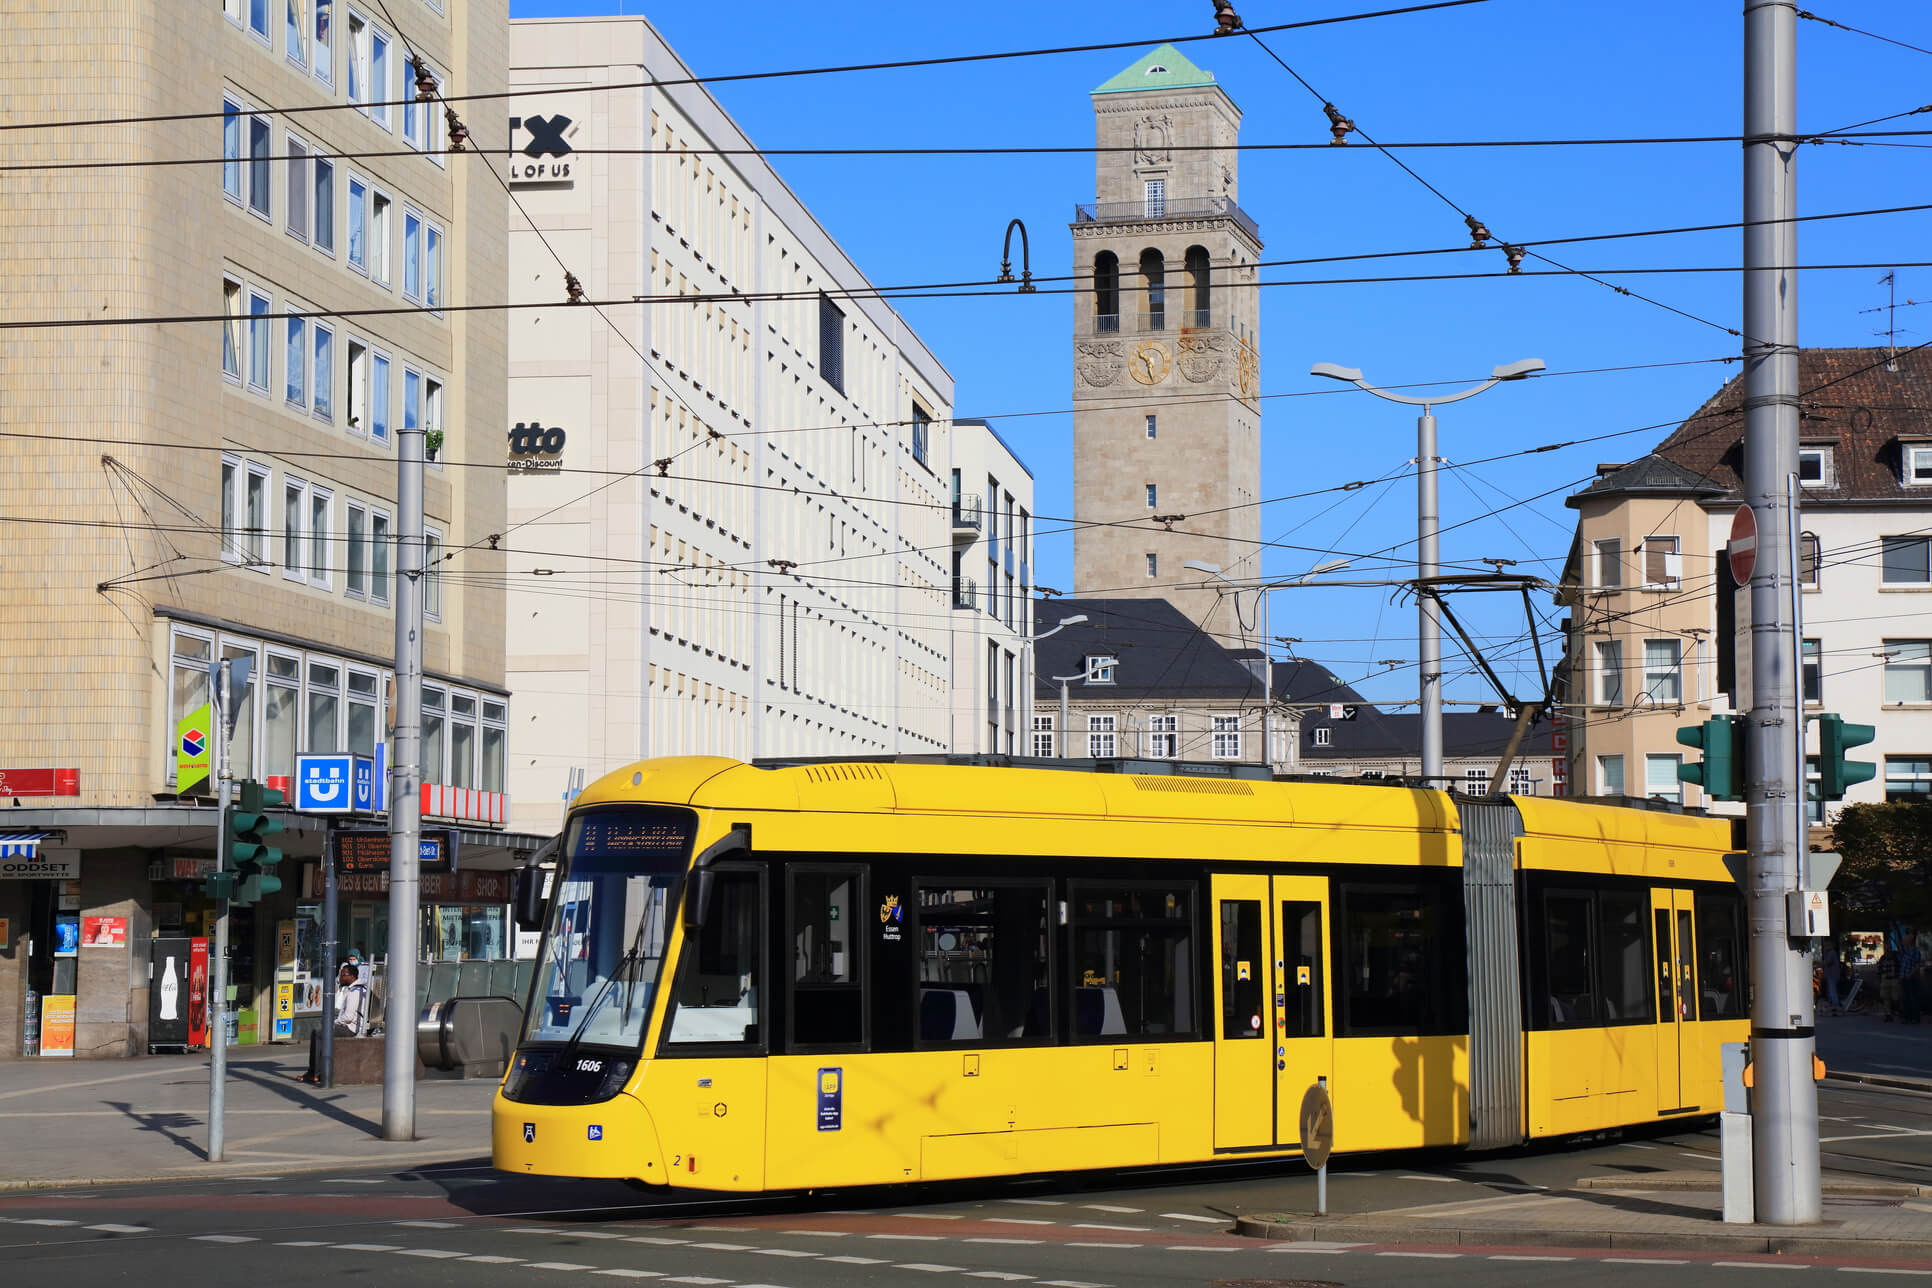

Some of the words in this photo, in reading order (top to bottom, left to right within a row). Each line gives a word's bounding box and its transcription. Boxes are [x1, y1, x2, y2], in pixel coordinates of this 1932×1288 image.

[524, 164, 545, 178] OF
[552, 163, 570, 178] US
[508, 422, 566, 454] tto
[3, 863, 70, 872] ODDSET
[476, 878, 498, 897] SHOP
[576, 1059, 601, 1072] 1606
[673, 1155, 681, 1167] 2
